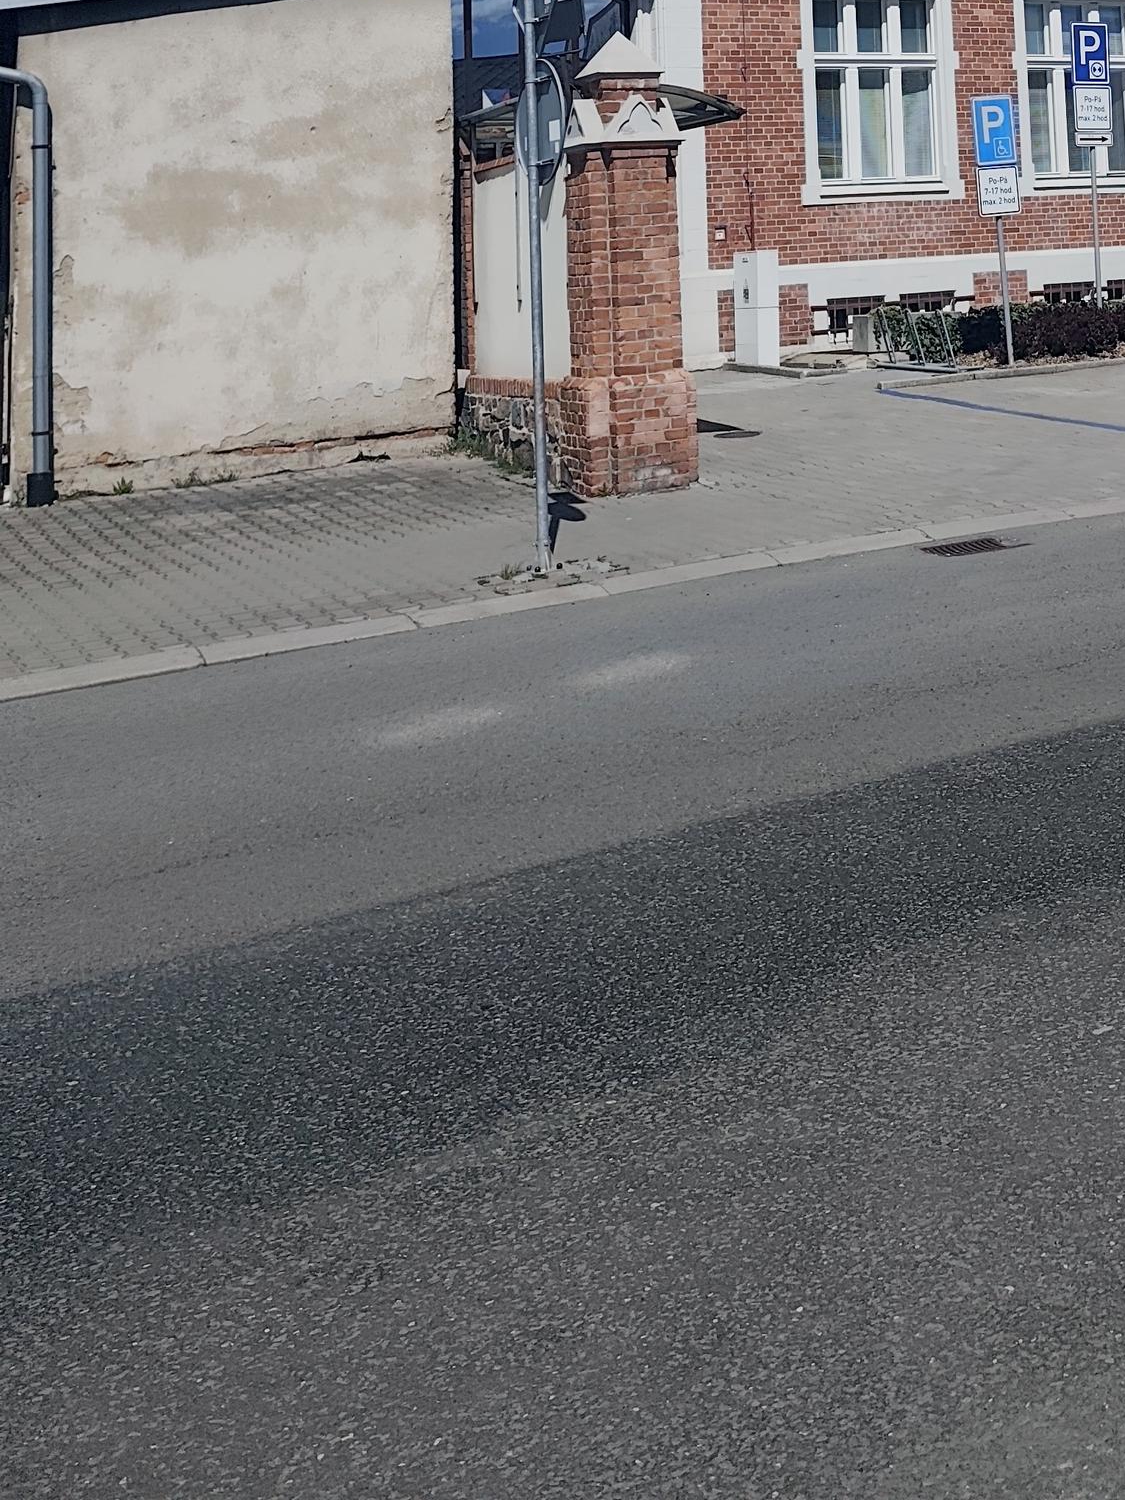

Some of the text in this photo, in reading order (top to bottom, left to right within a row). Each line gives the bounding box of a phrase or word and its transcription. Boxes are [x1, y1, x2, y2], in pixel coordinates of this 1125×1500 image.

[1079, 30, 1101, 65] P
[981, 105, 1005, 144] P
[988, 175, 1008, 185] Po-Pá
[998, 196, 1003, 205] 2
